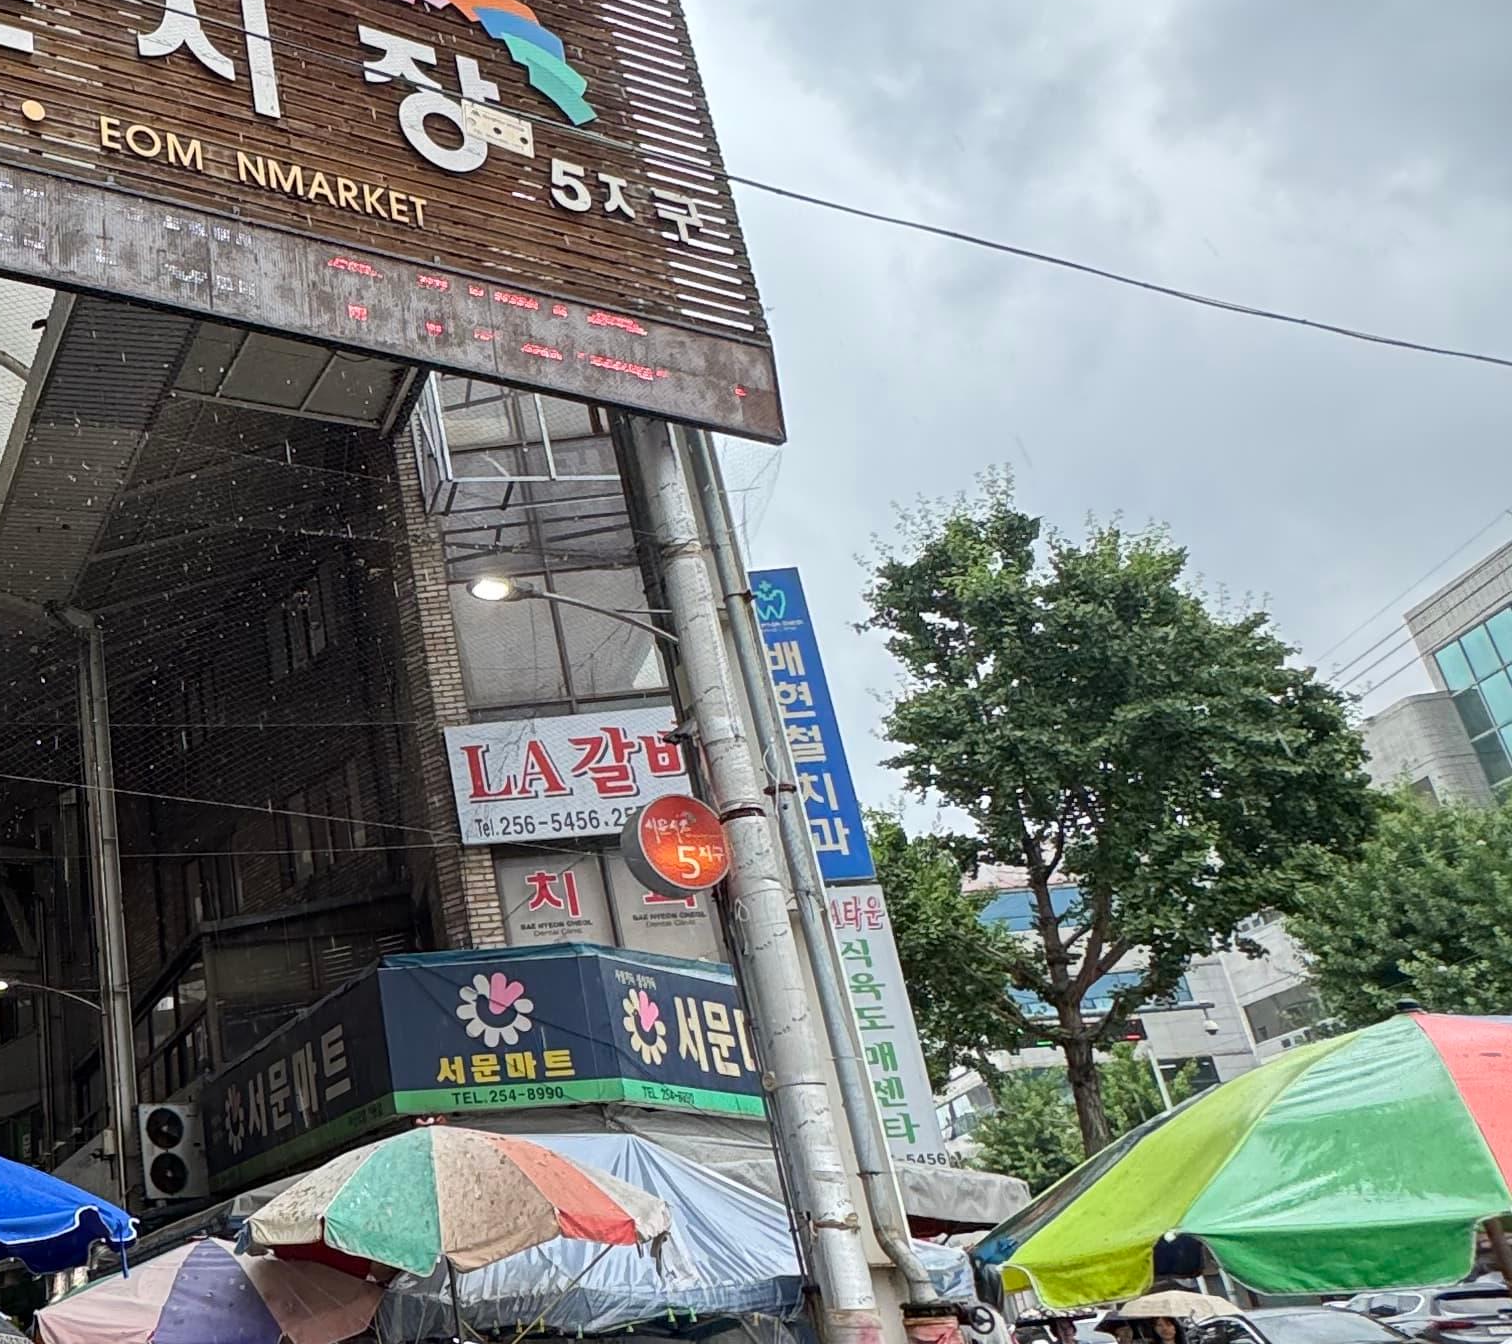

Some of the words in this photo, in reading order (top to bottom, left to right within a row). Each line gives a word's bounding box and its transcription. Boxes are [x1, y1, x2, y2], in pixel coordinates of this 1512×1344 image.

[100, 116, 204, 171] EOM
[237, 151, 428, 228] NMARKET
[525, 870, 581, 918] 치
[248, 1023, 352, 1137] 서문마트
[436, 1048, 576, 1085] 서문마트
[451, 1085, 565, 1106] TEL.254-8990
[890, 1152, 948, 1166] -5456
